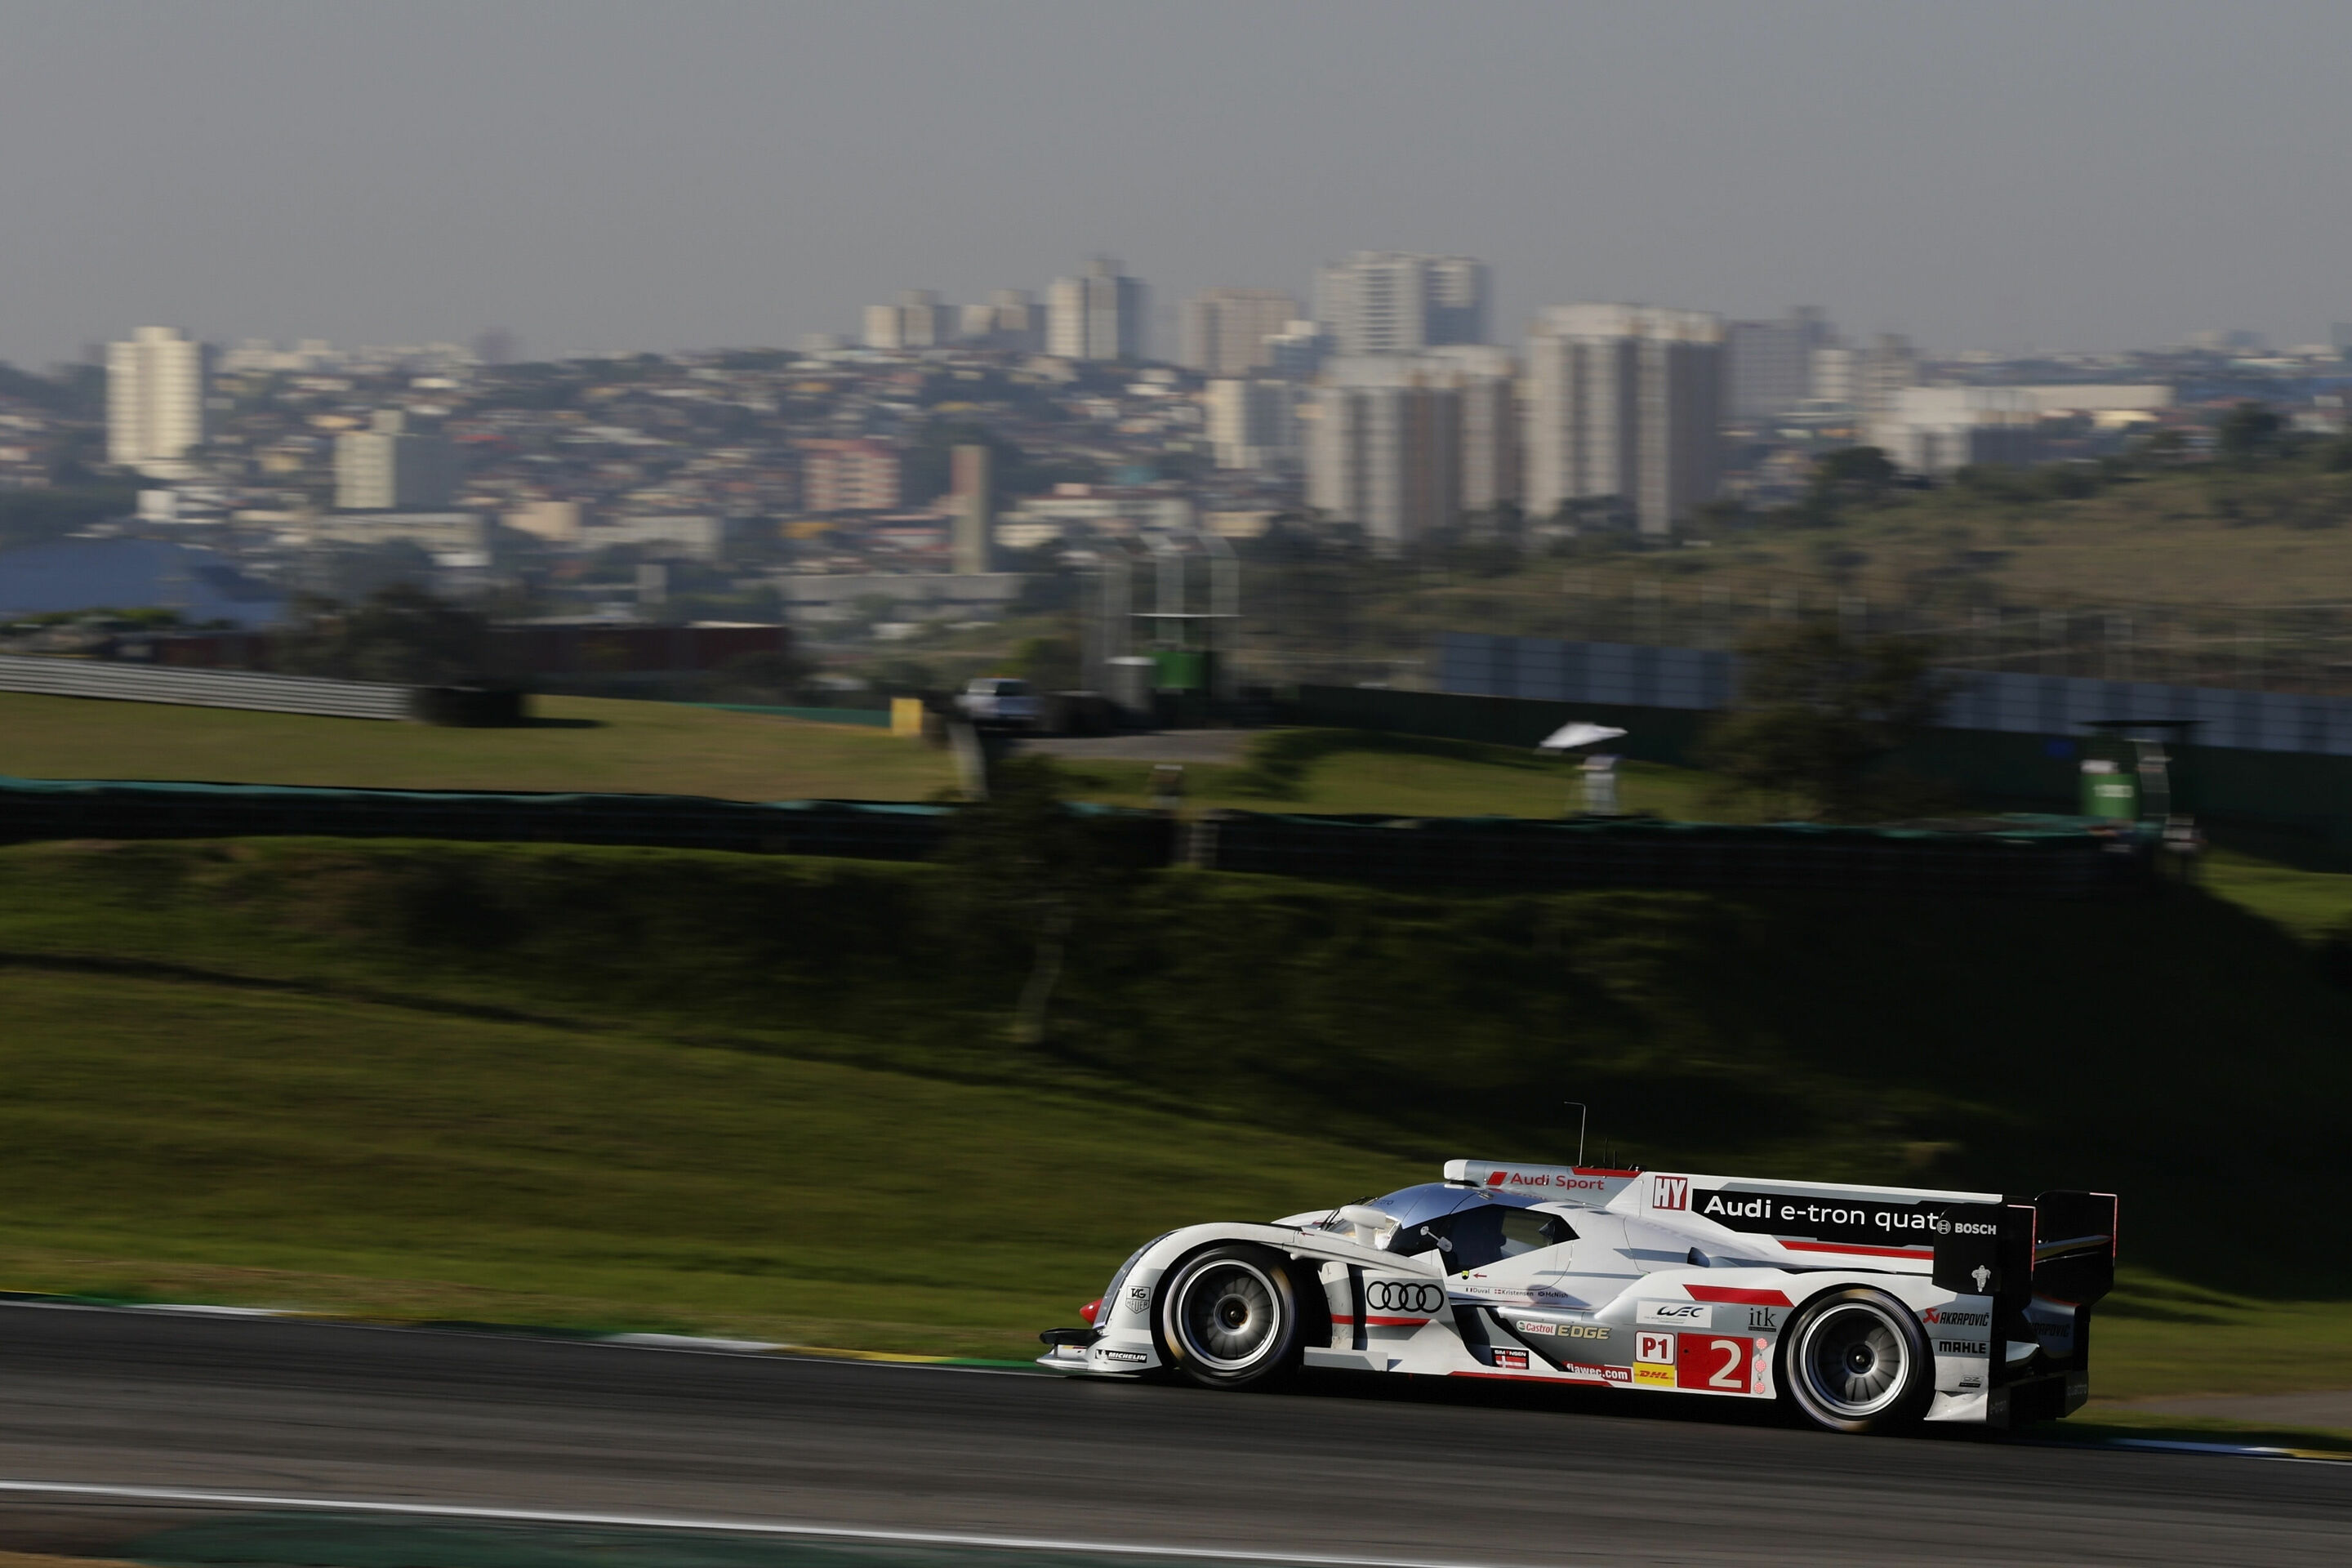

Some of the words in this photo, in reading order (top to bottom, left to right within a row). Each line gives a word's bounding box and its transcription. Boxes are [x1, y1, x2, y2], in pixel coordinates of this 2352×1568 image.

[1511, 1173, 1550, 1186] Audi
[1556, 1175, 1604, 1190] Sport
[1654, 1178, 1686, 1209] HY
[1704, 1196, 1771, 1218] Audi
[1780, 1205, 1865, 1225] e-tron
[1954, 1223, 1997, 1236] BOSCH
[1131, 1288, 1147, 1298] TAG
[1127, 1299, 1149, 1312] HEUER
[1657, 1306, 1704, 1317] WEC
[1749, 1307, 1776, 1327] itk
[1940, 1312, 1989, 1327] AKRAPOVIČ
[1526, 1322, 1555, 1334] Castrol
[1557, 1325, 1611, 1340] EDGE
[1642, 1338, 1668, 1359] P1
[1939, 1341, 1987, 1354] MAHLE
[1108, 1352, 1147, 1361] MICHELIN
[1708, 1339, 1743, 1388] 2
[1566, 1362, 1628, 1380] fiawec.com
[1639, 1370, 1669, 1379] DHL
